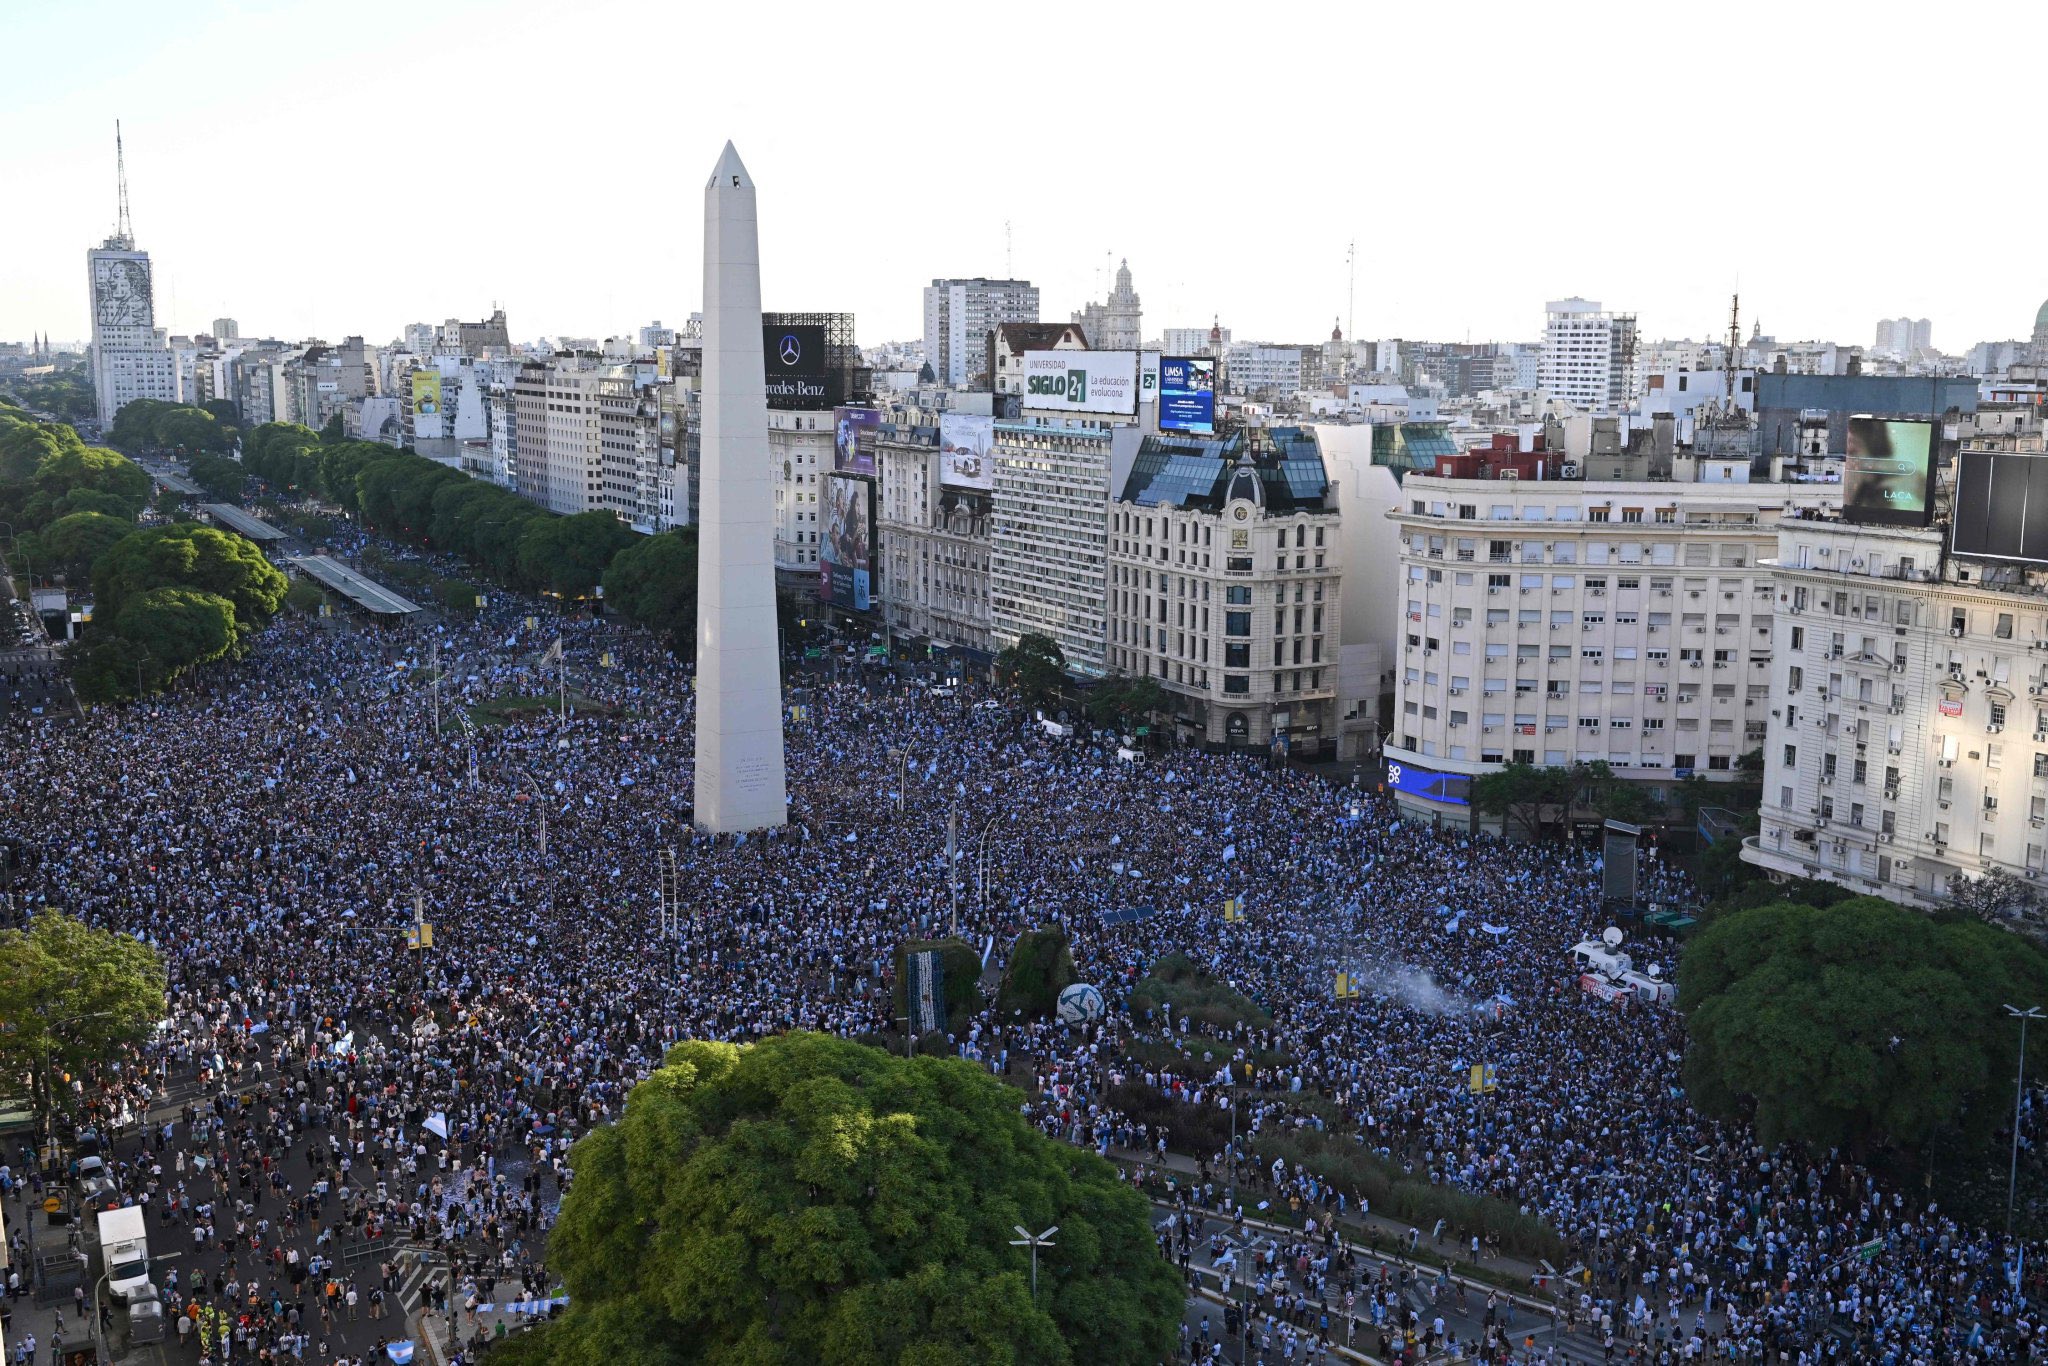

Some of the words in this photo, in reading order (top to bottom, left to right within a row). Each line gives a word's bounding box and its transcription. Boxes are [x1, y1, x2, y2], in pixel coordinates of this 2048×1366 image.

[1029, 360, 1066, 370] UNIVERSIDAD
[1164, 366, 1184, 377] UMSA
[1091, 376, 1098, 385] La
[1099, 376, 1129, 387] educación
[1144, 376, 1156, 389] 21
[766, 380, 825, 396] rcedes-Benz
[1027, 374, 1066, 396] SIGLO
[1069, 375, 1083, 402] 21
[1091, 386, 1123, 398] evoluciona
